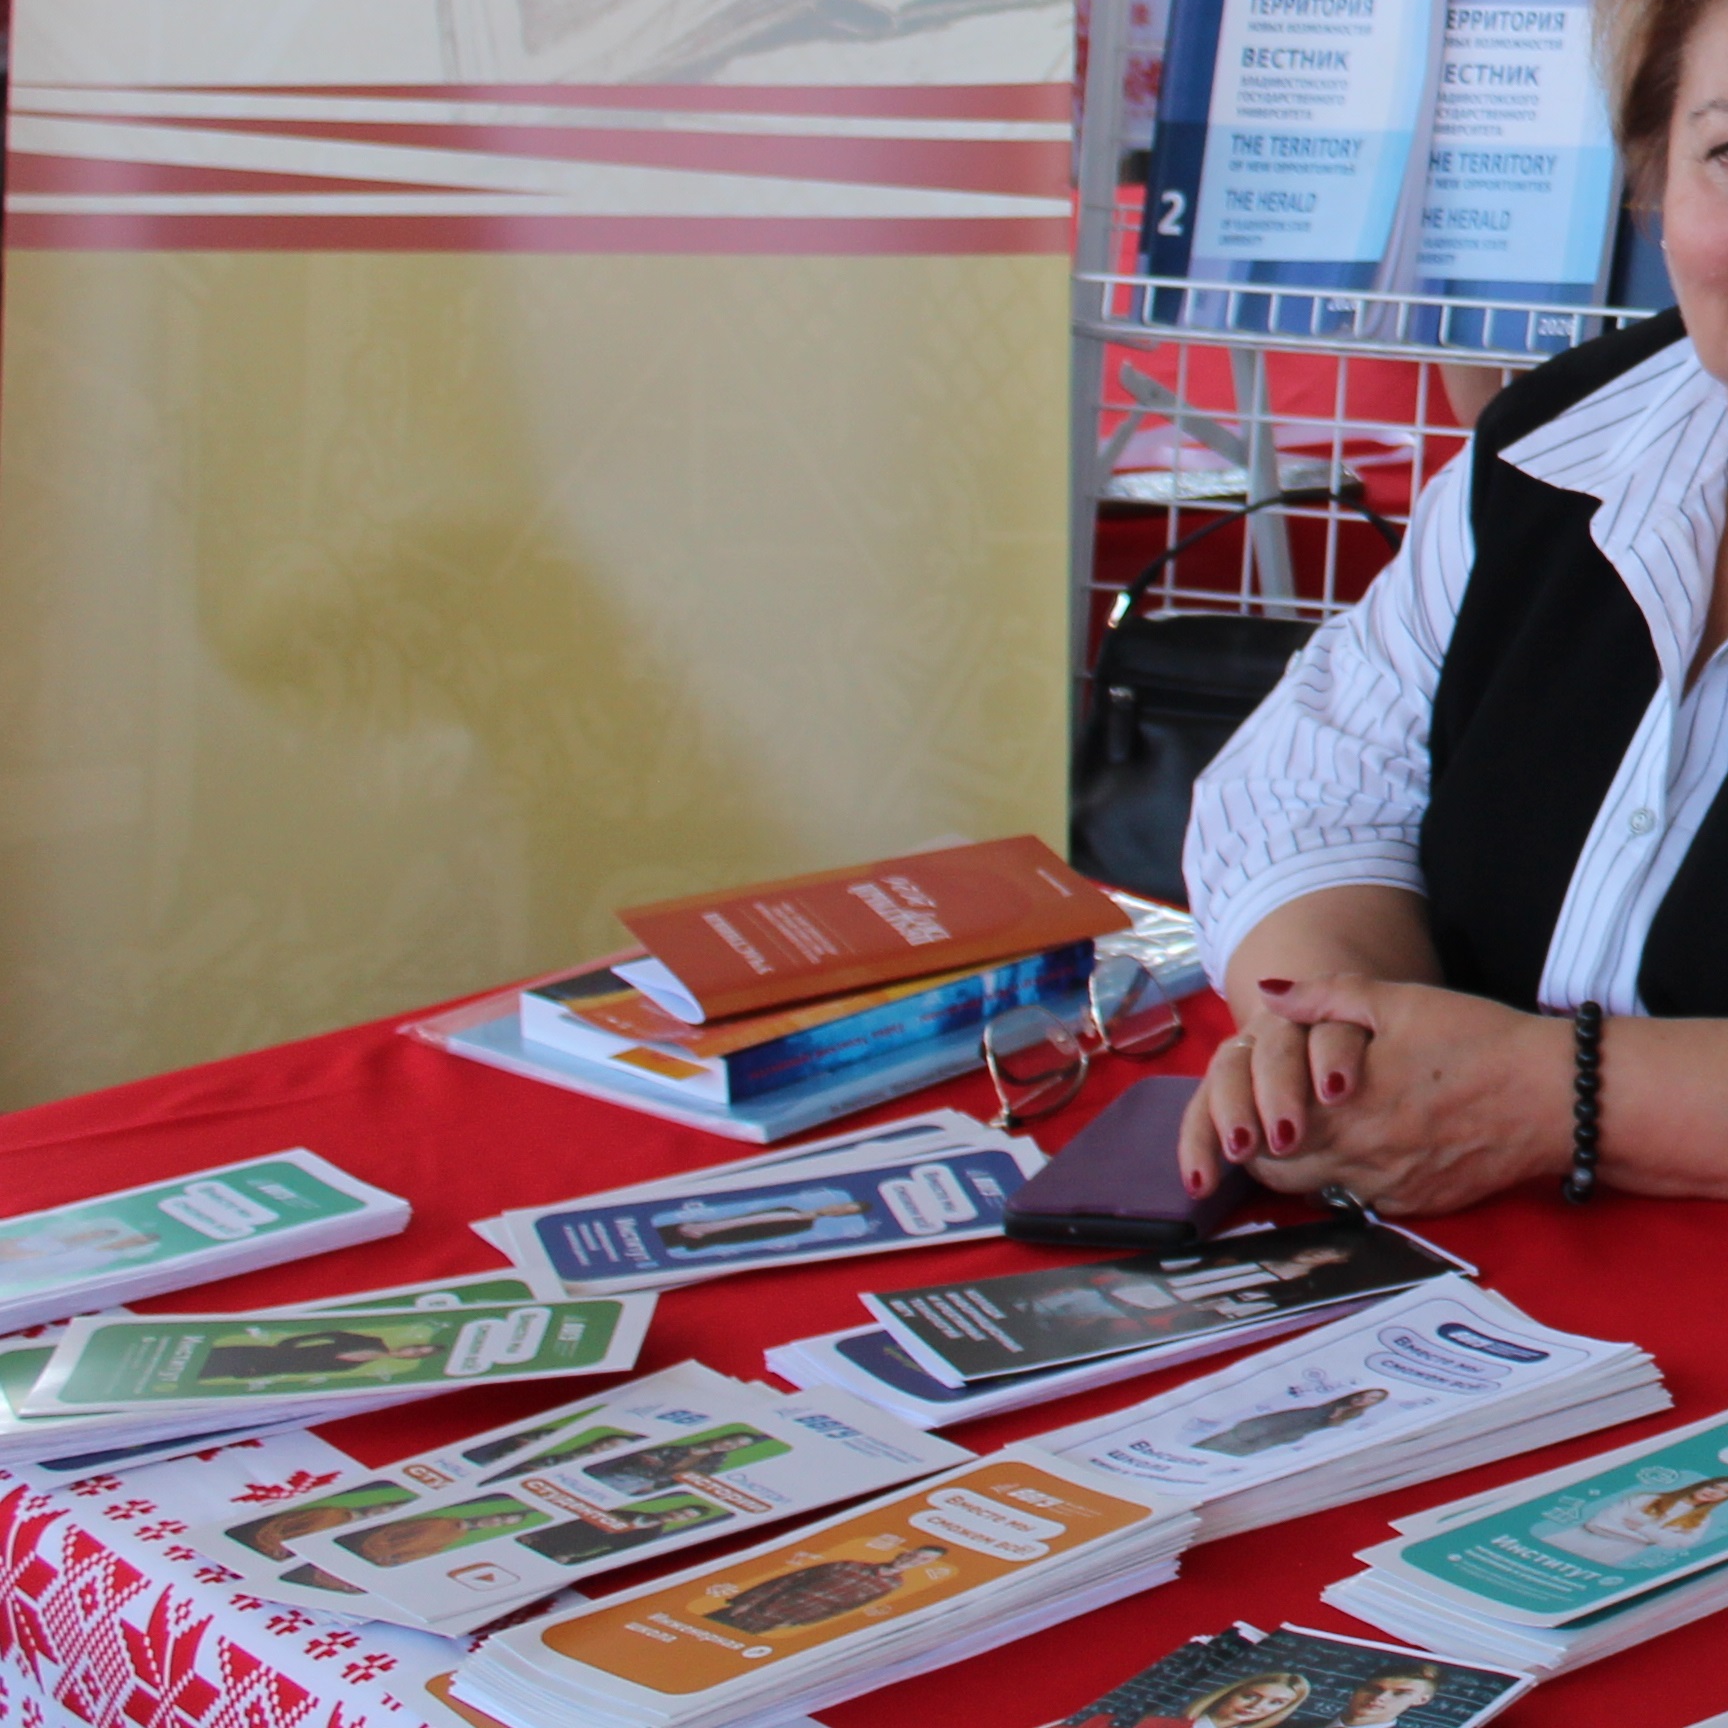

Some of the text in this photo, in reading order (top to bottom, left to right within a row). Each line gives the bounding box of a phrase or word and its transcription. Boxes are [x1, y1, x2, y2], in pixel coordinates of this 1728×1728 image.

[1241, 47, 1349, 71] ВЕСТНИК
[1443, 64, 1540, 87] ЕСТНИК
[1231, 134, 1363, 160] THE TERRITORY
[1459, 153, 1557, 176] TERRITORY
[1157, 189, 1187, 236] 2
[1225, 189, 1317, 213] THE HERALD
[1490, 1534, 1602, 1583] Институт
